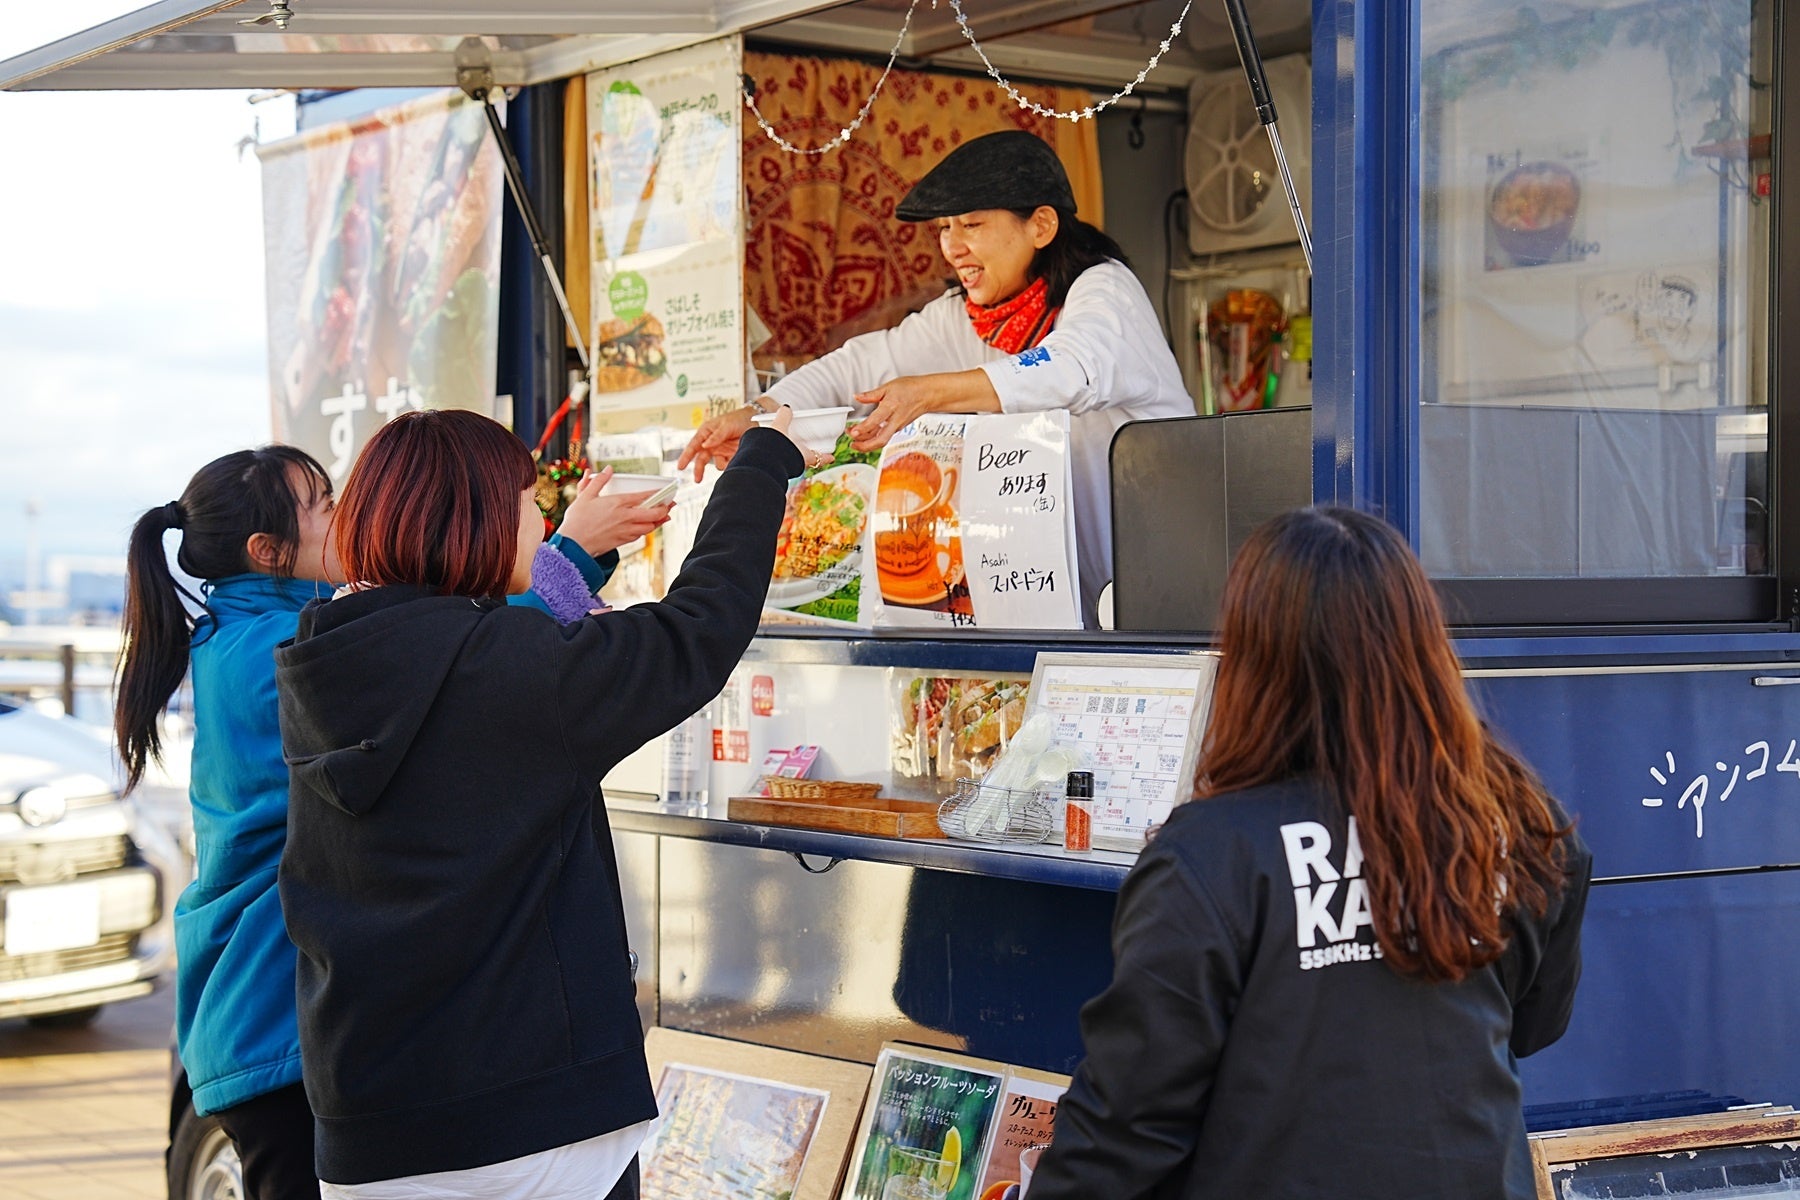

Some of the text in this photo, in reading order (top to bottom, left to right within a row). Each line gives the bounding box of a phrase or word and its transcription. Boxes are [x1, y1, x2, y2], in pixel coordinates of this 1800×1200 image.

[978, 443, 1031, 472] Beer
[998, 472, 1049, 496] あります
[981, 553, 1009, 569] Asahi
[989, 568, 1055, 593] スーパードライ
[1280, 815, 1365, 888] RA
[1294, 878, 1377, 948] KA
[888, 1065, 997, 1099] パッションフルーツソーダ
